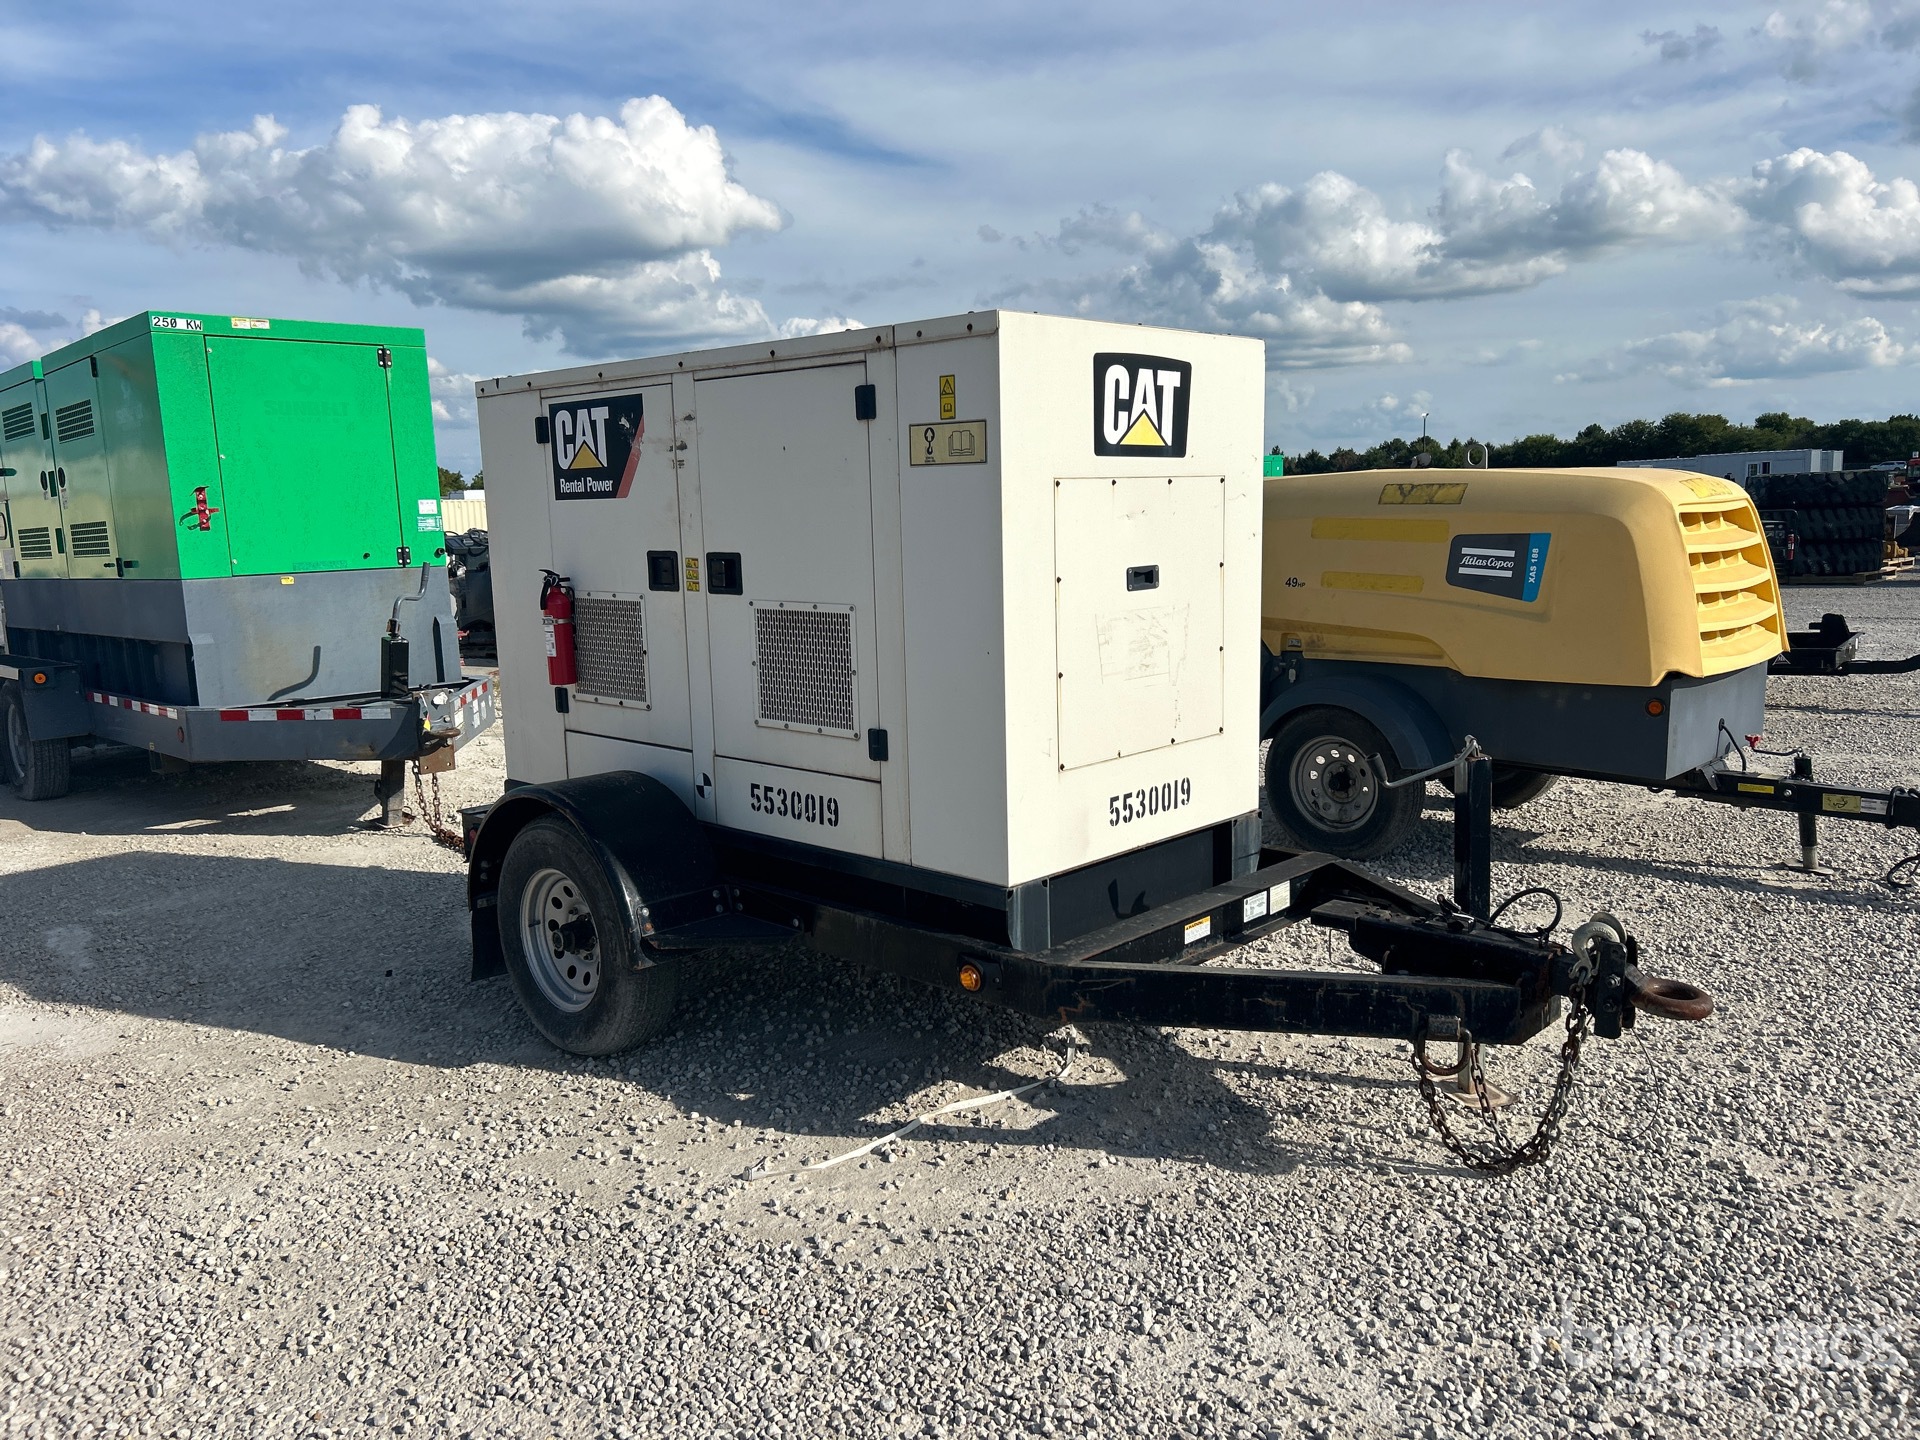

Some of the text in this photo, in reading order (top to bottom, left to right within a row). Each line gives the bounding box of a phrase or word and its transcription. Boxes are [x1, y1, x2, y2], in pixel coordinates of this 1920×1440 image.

[153, 316, 202, 330] 250 KW
[1103, 364, 1181, 446] CAT
[555, 406, 609, 470] CAT
[560, 476, 614, 494] Rental Power
[1460, 555, 1515, 569] Atlas Copco
[1528, 548, 1540, 584] XAS 188
[750, 782, 839, 827] 5530019
[1109, 777, 1191, 827] 5530019
